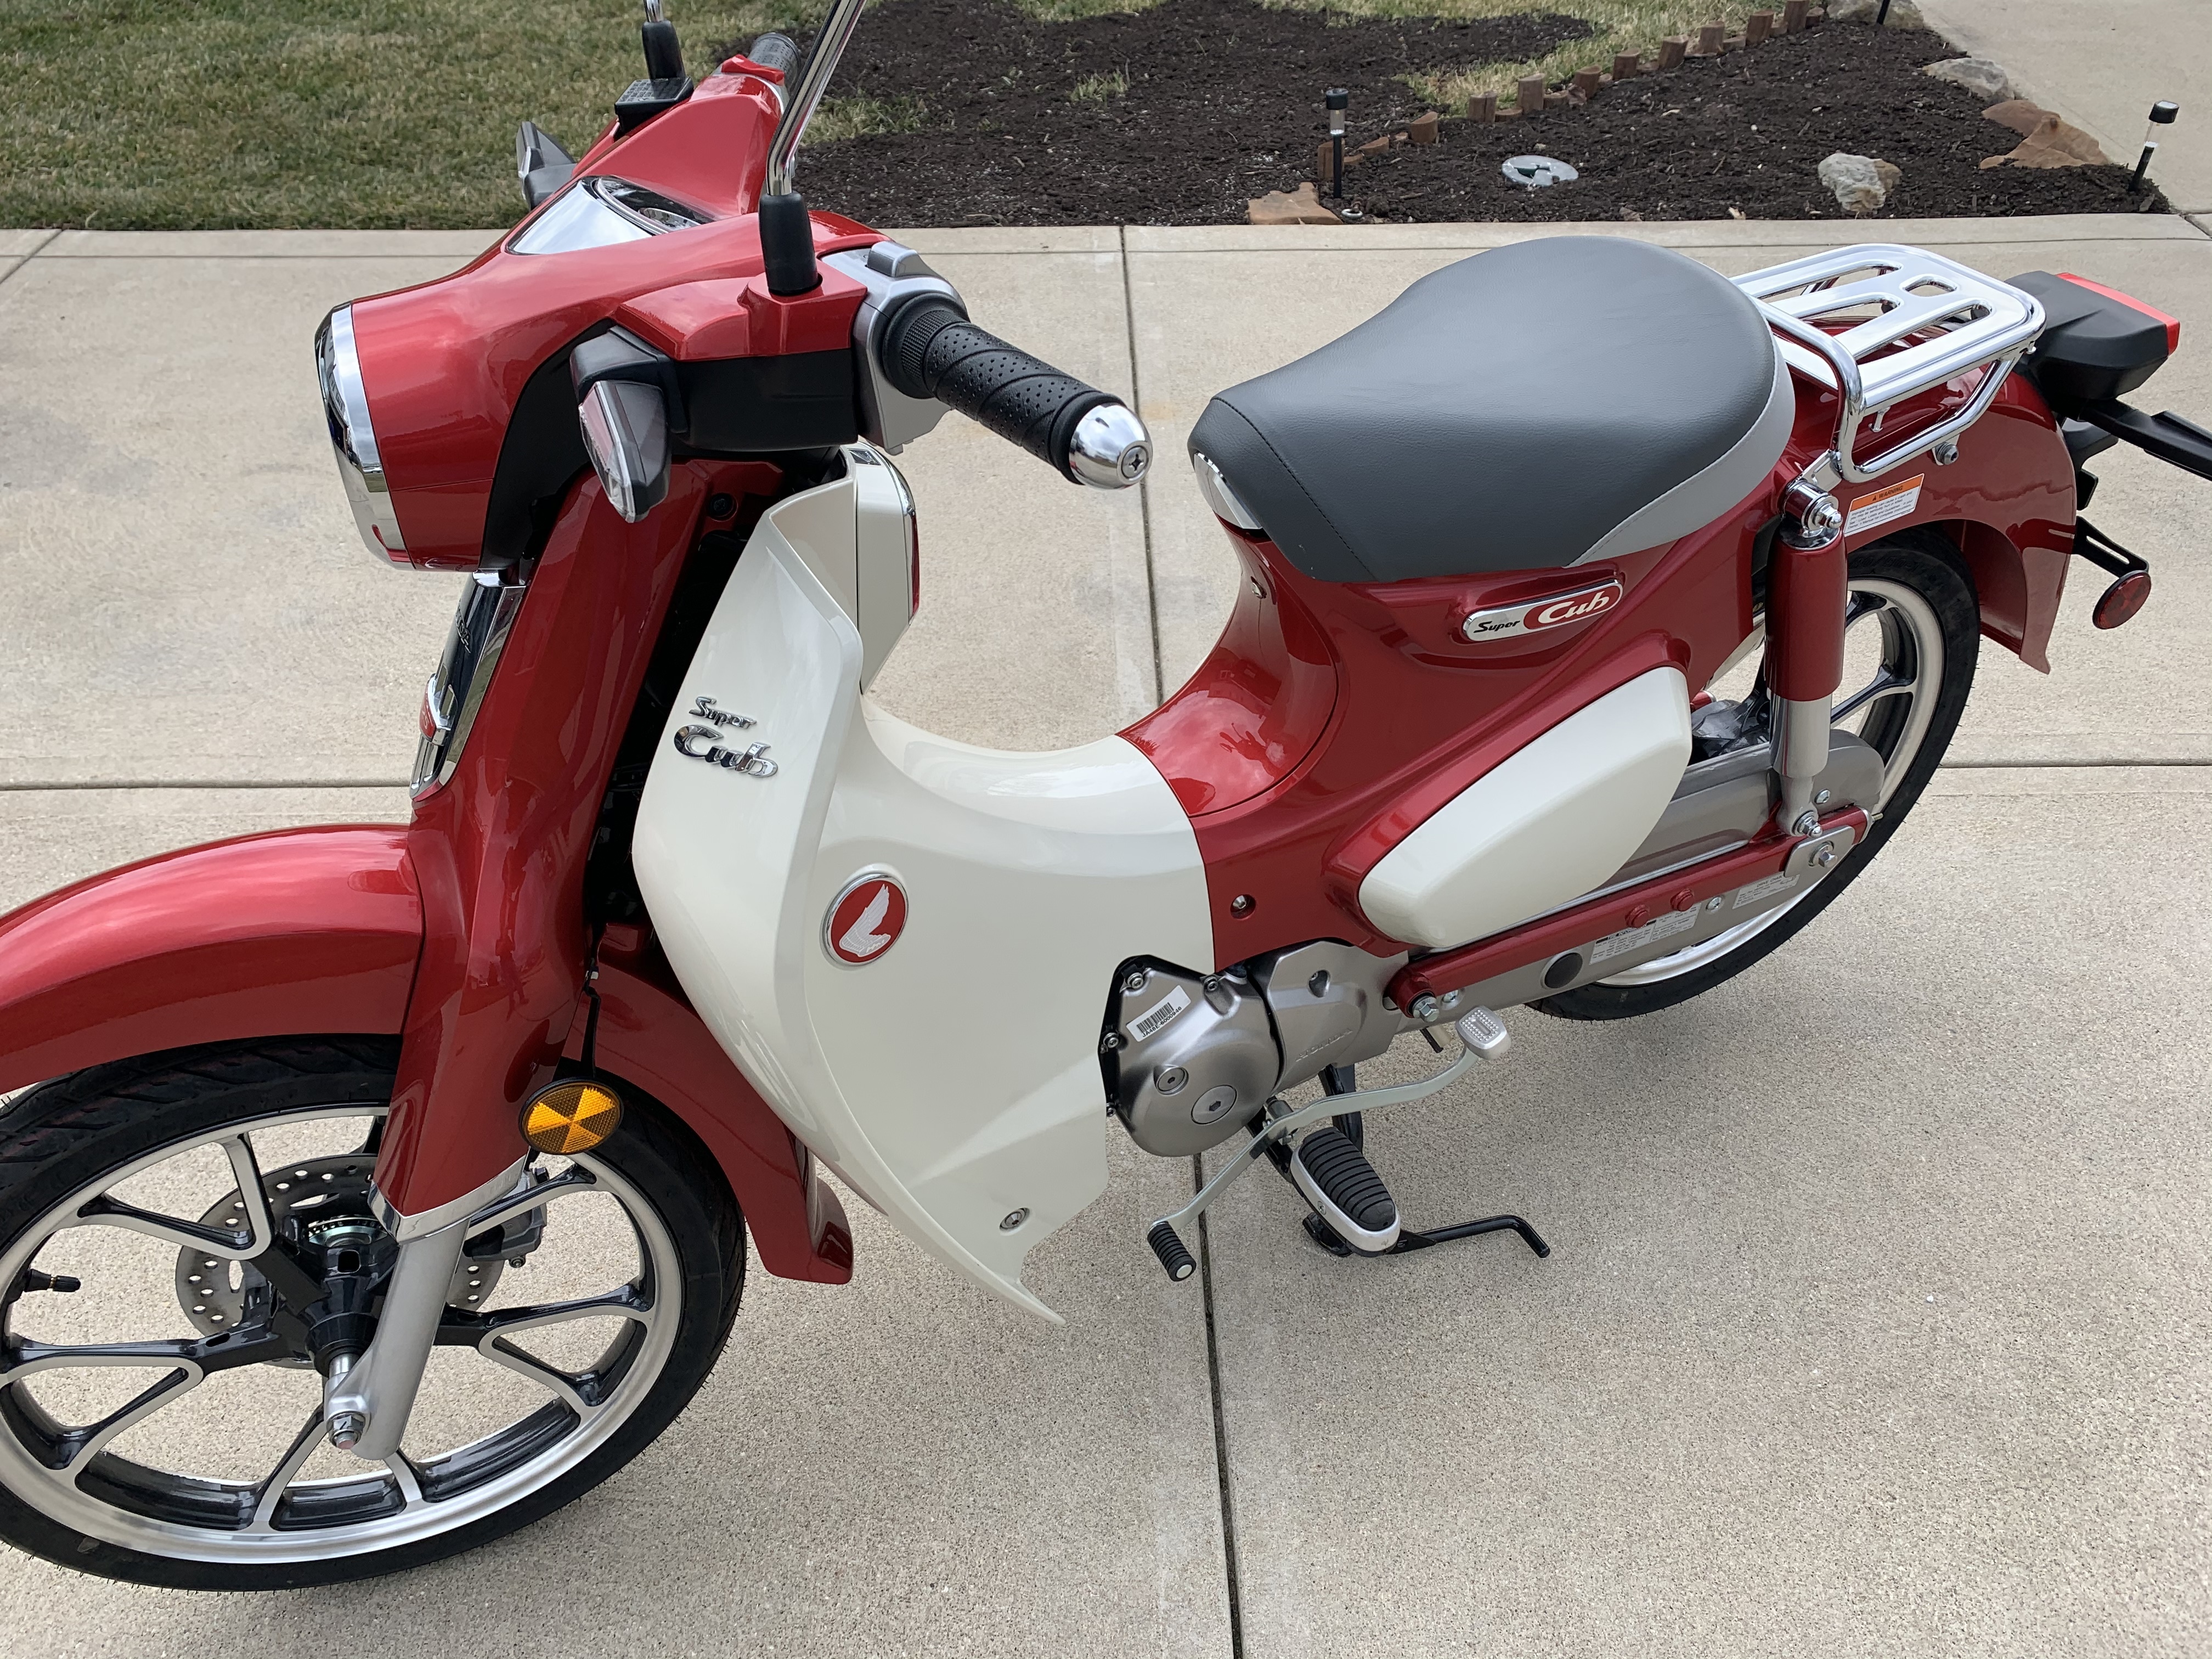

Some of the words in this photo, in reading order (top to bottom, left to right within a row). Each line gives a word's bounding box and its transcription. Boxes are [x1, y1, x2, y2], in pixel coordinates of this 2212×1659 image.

[1878, 485, 1903, 499] WARNING
[1851, 508, 1866, 517] Improper
[1474, 620, 1520, 633] Super
[1538, 590, 1610, 623] Cub
[689, 696, 758, 729] Super
[674, 724, 778, 777] Cub
